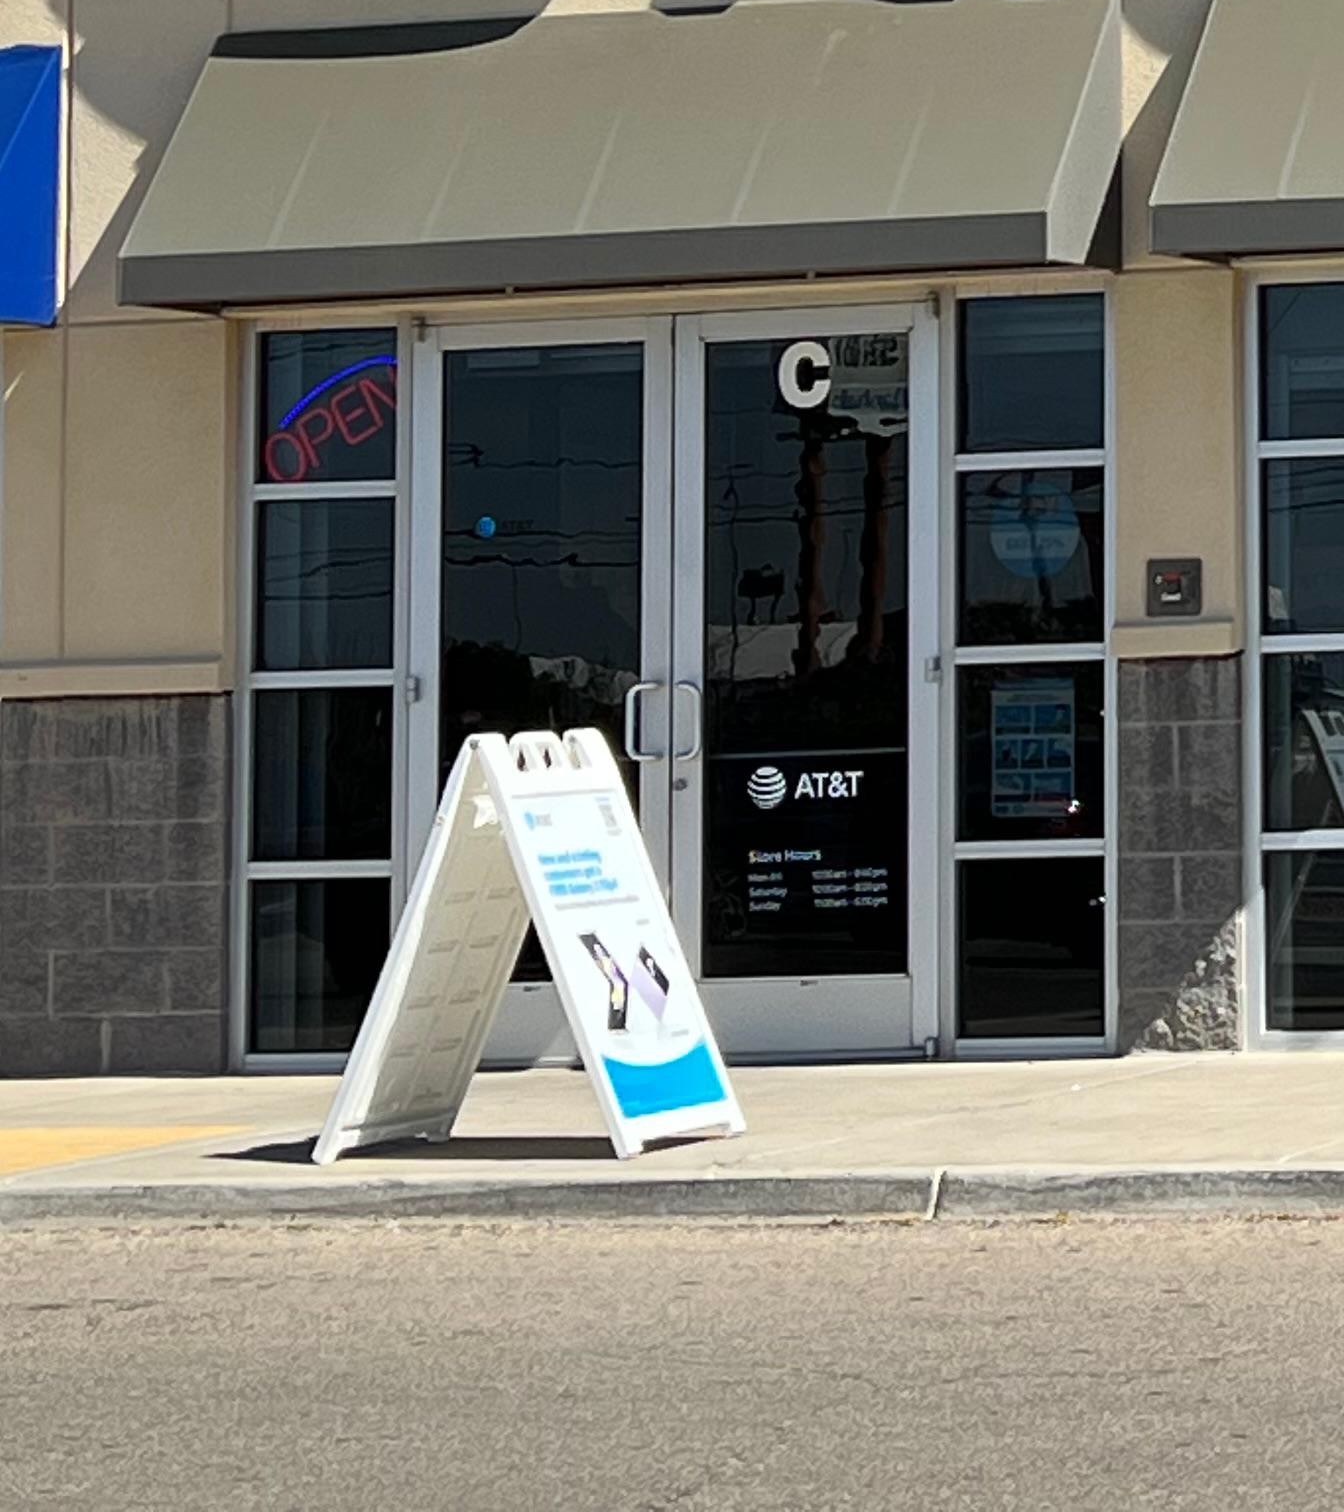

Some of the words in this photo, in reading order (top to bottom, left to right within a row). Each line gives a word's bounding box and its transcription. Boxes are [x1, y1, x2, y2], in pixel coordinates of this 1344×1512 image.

[778, 340, 832, 409] C
[264, 361, 397, 483] OPEN
[794, 770, 865, 800] AT&T
